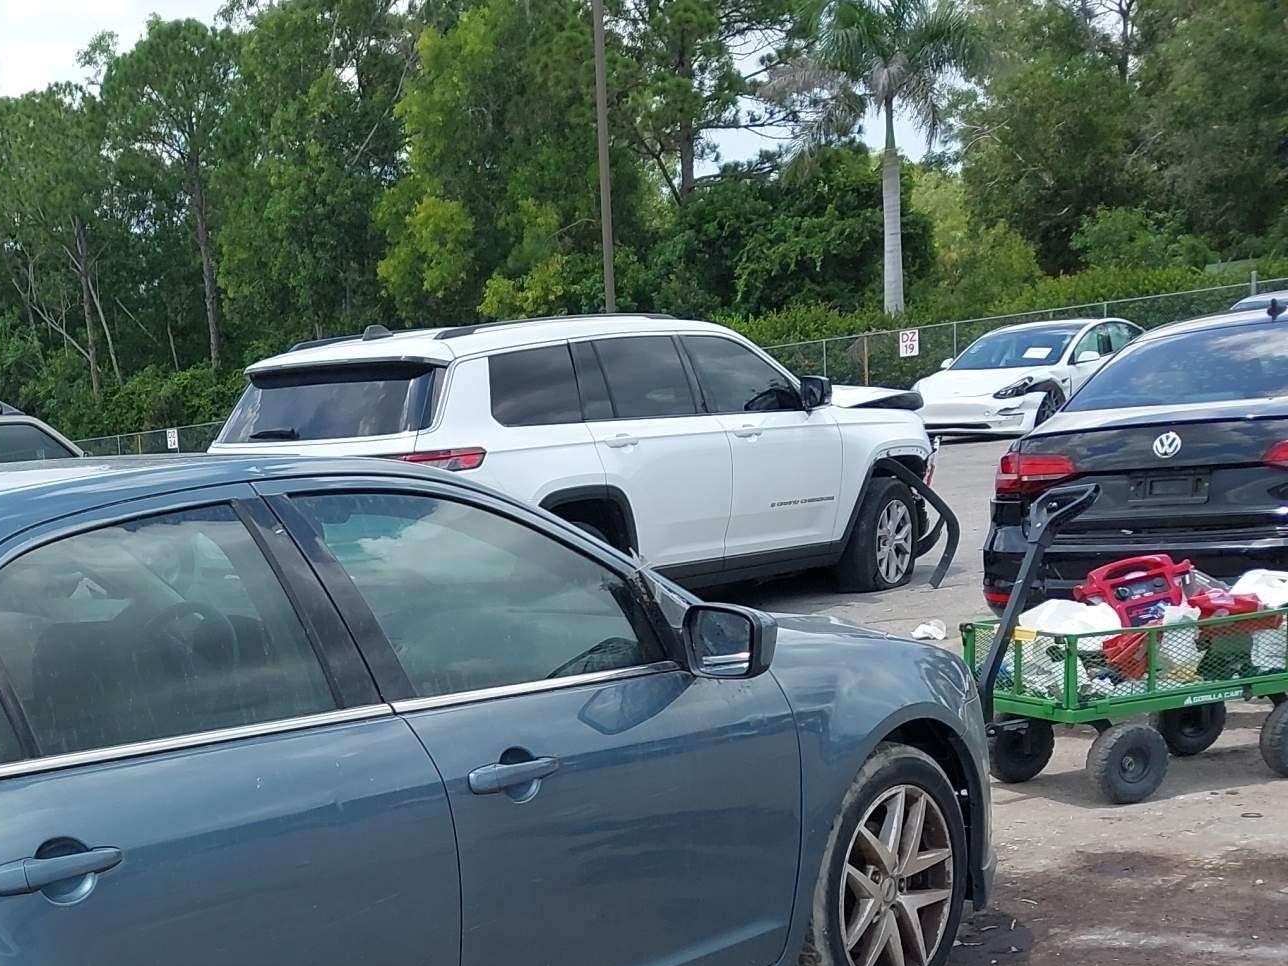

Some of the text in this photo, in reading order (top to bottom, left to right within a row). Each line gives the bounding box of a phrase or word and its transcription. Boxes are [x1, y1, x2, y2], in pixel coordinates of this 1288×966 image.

[901, 331, 916, 343] DZ
[904, 343, 915, 354] 19
[1192, 692, 1223, 703] GORILLA
